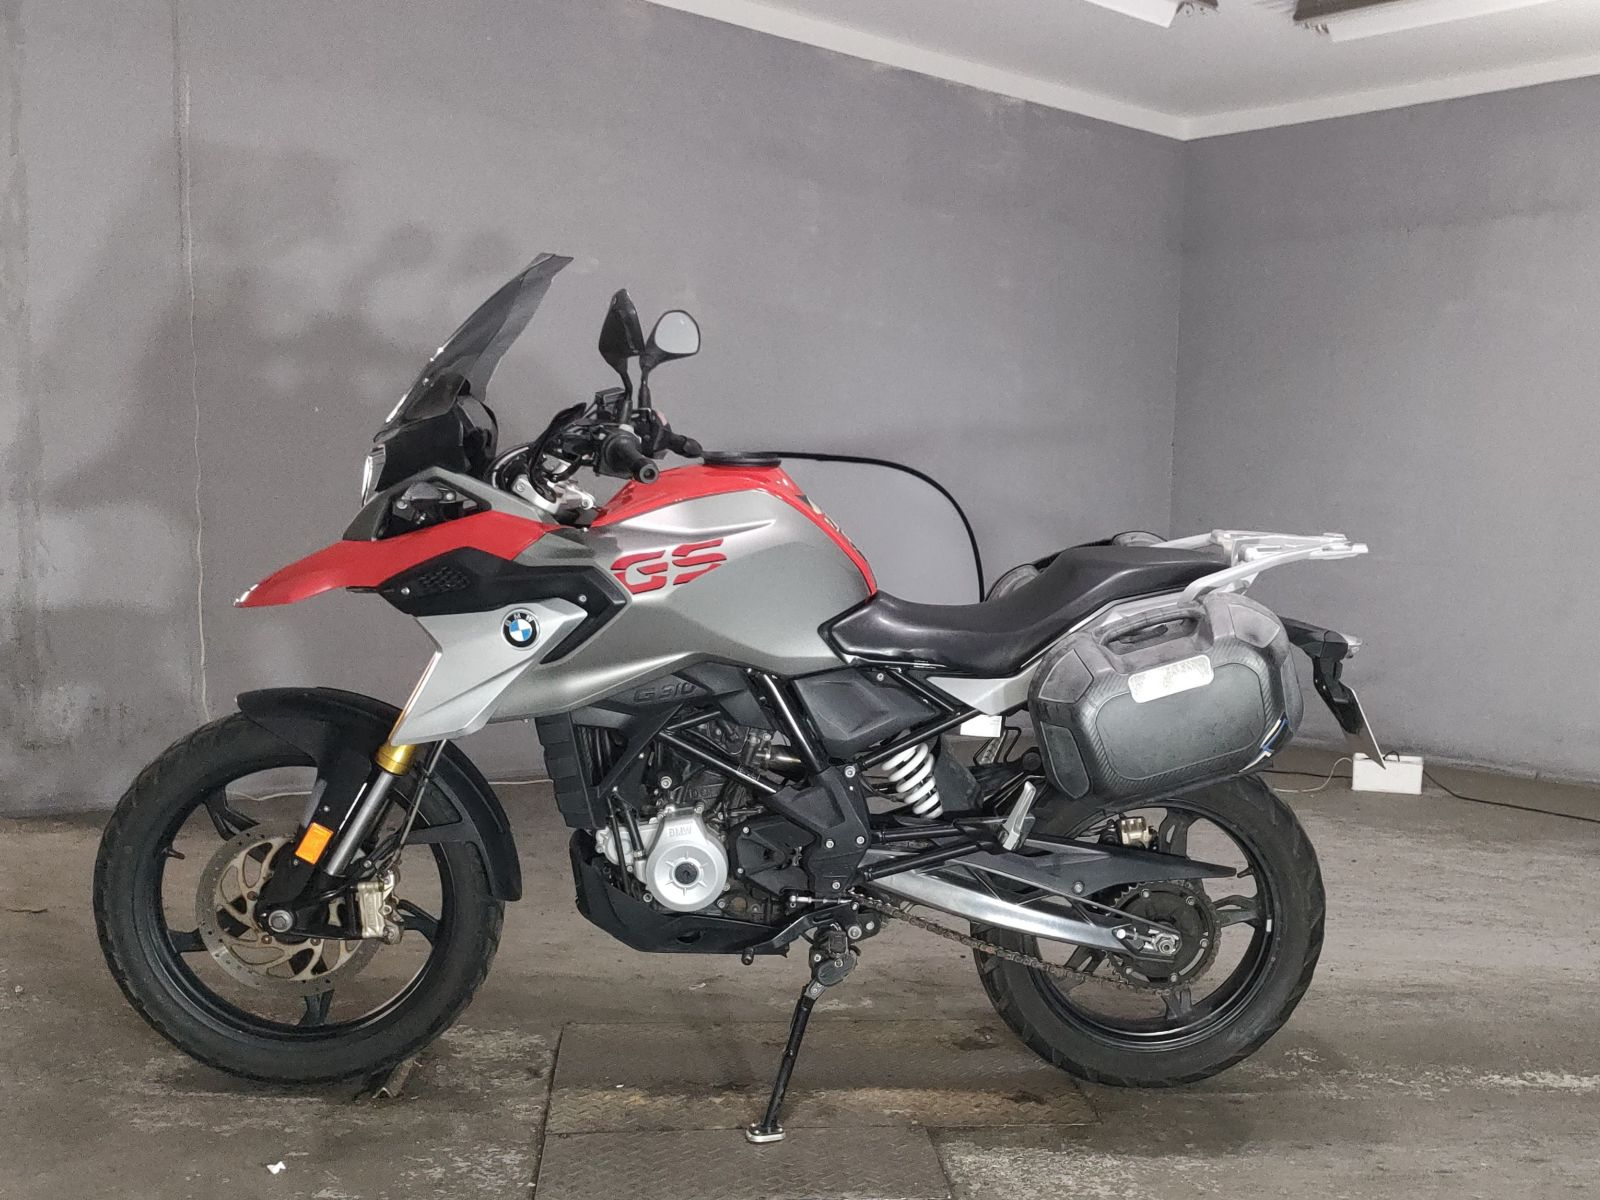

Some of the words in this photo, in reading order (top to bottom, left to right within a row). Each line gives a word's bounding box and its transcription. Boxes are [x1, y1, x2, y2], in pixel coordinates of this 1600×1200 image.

[611, 538, 727, 594] GS
[503, 610, 535, 625] BMW
[633, 688, 655, 703] G
[659, 681, 695, 699] 310
[668, 825, 693, 838] BMW
